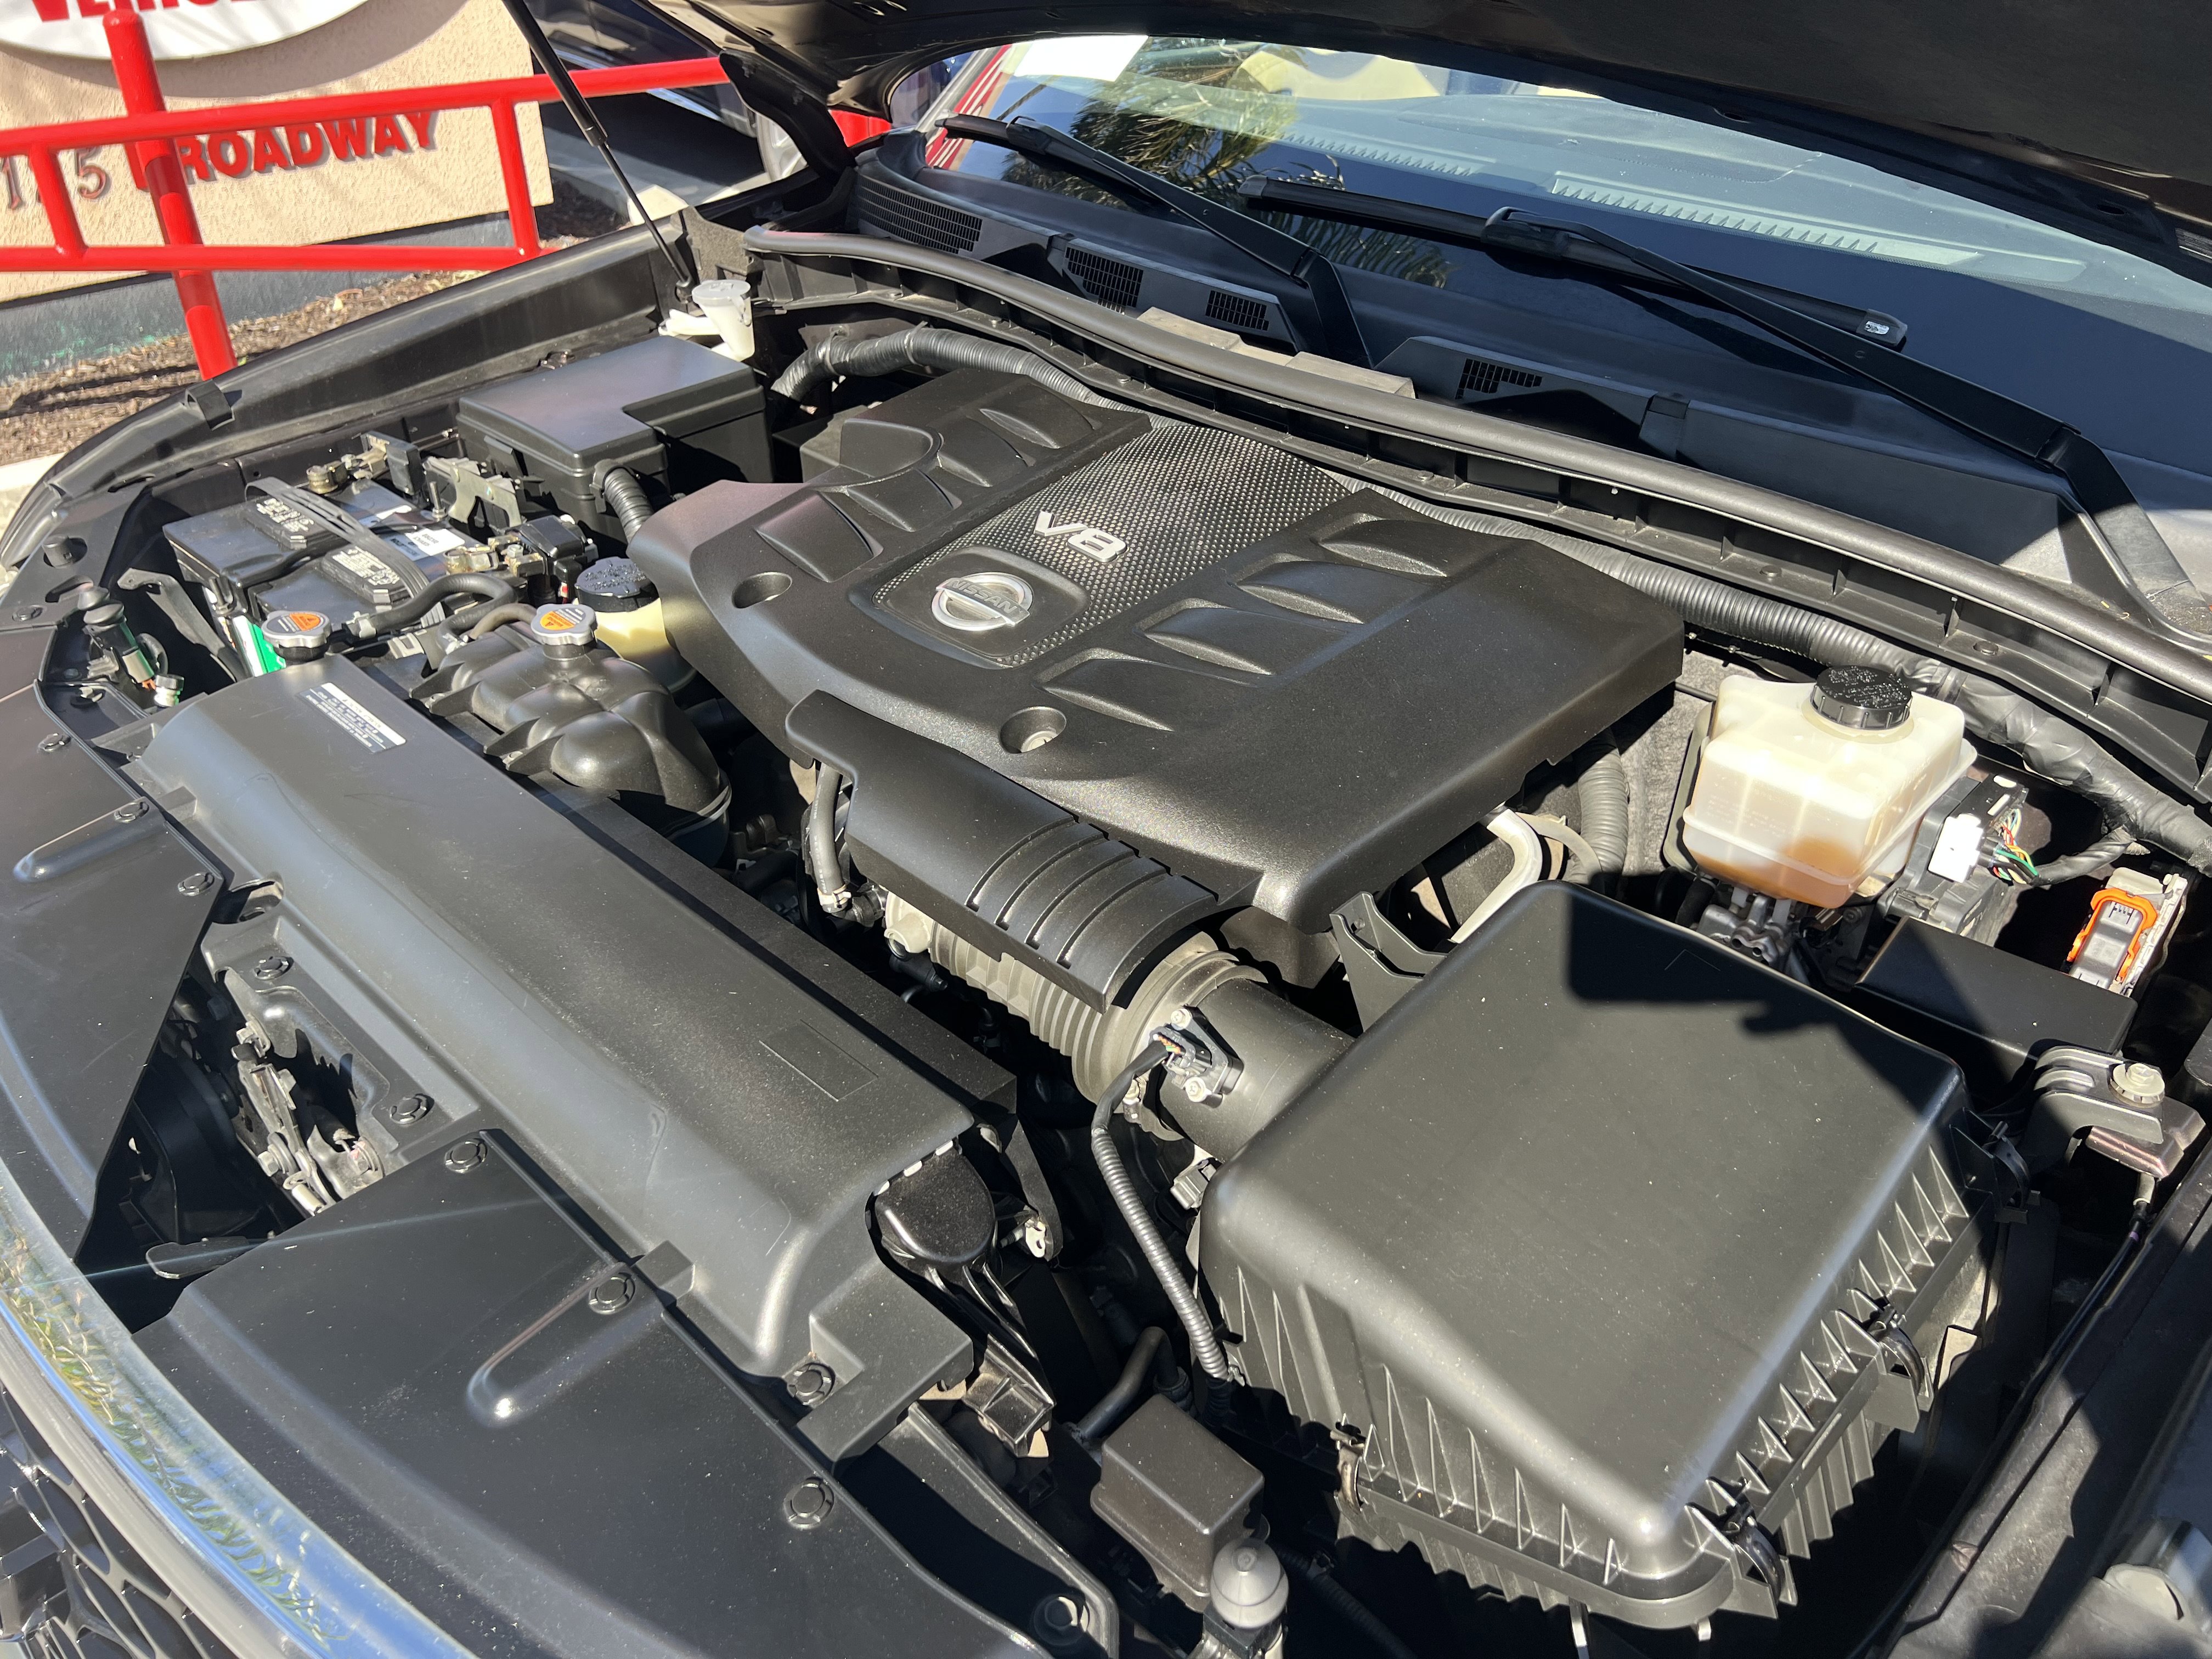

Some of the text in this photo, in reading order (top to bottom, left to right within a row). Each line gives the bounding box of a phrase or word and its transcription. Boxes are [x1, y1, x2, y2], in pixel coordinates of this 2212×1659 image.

[124, 112, 433, 190] ROADWAY
[1034, 511, 1127, 562] V8
[951, 578, 1018, 614] NISSAN
